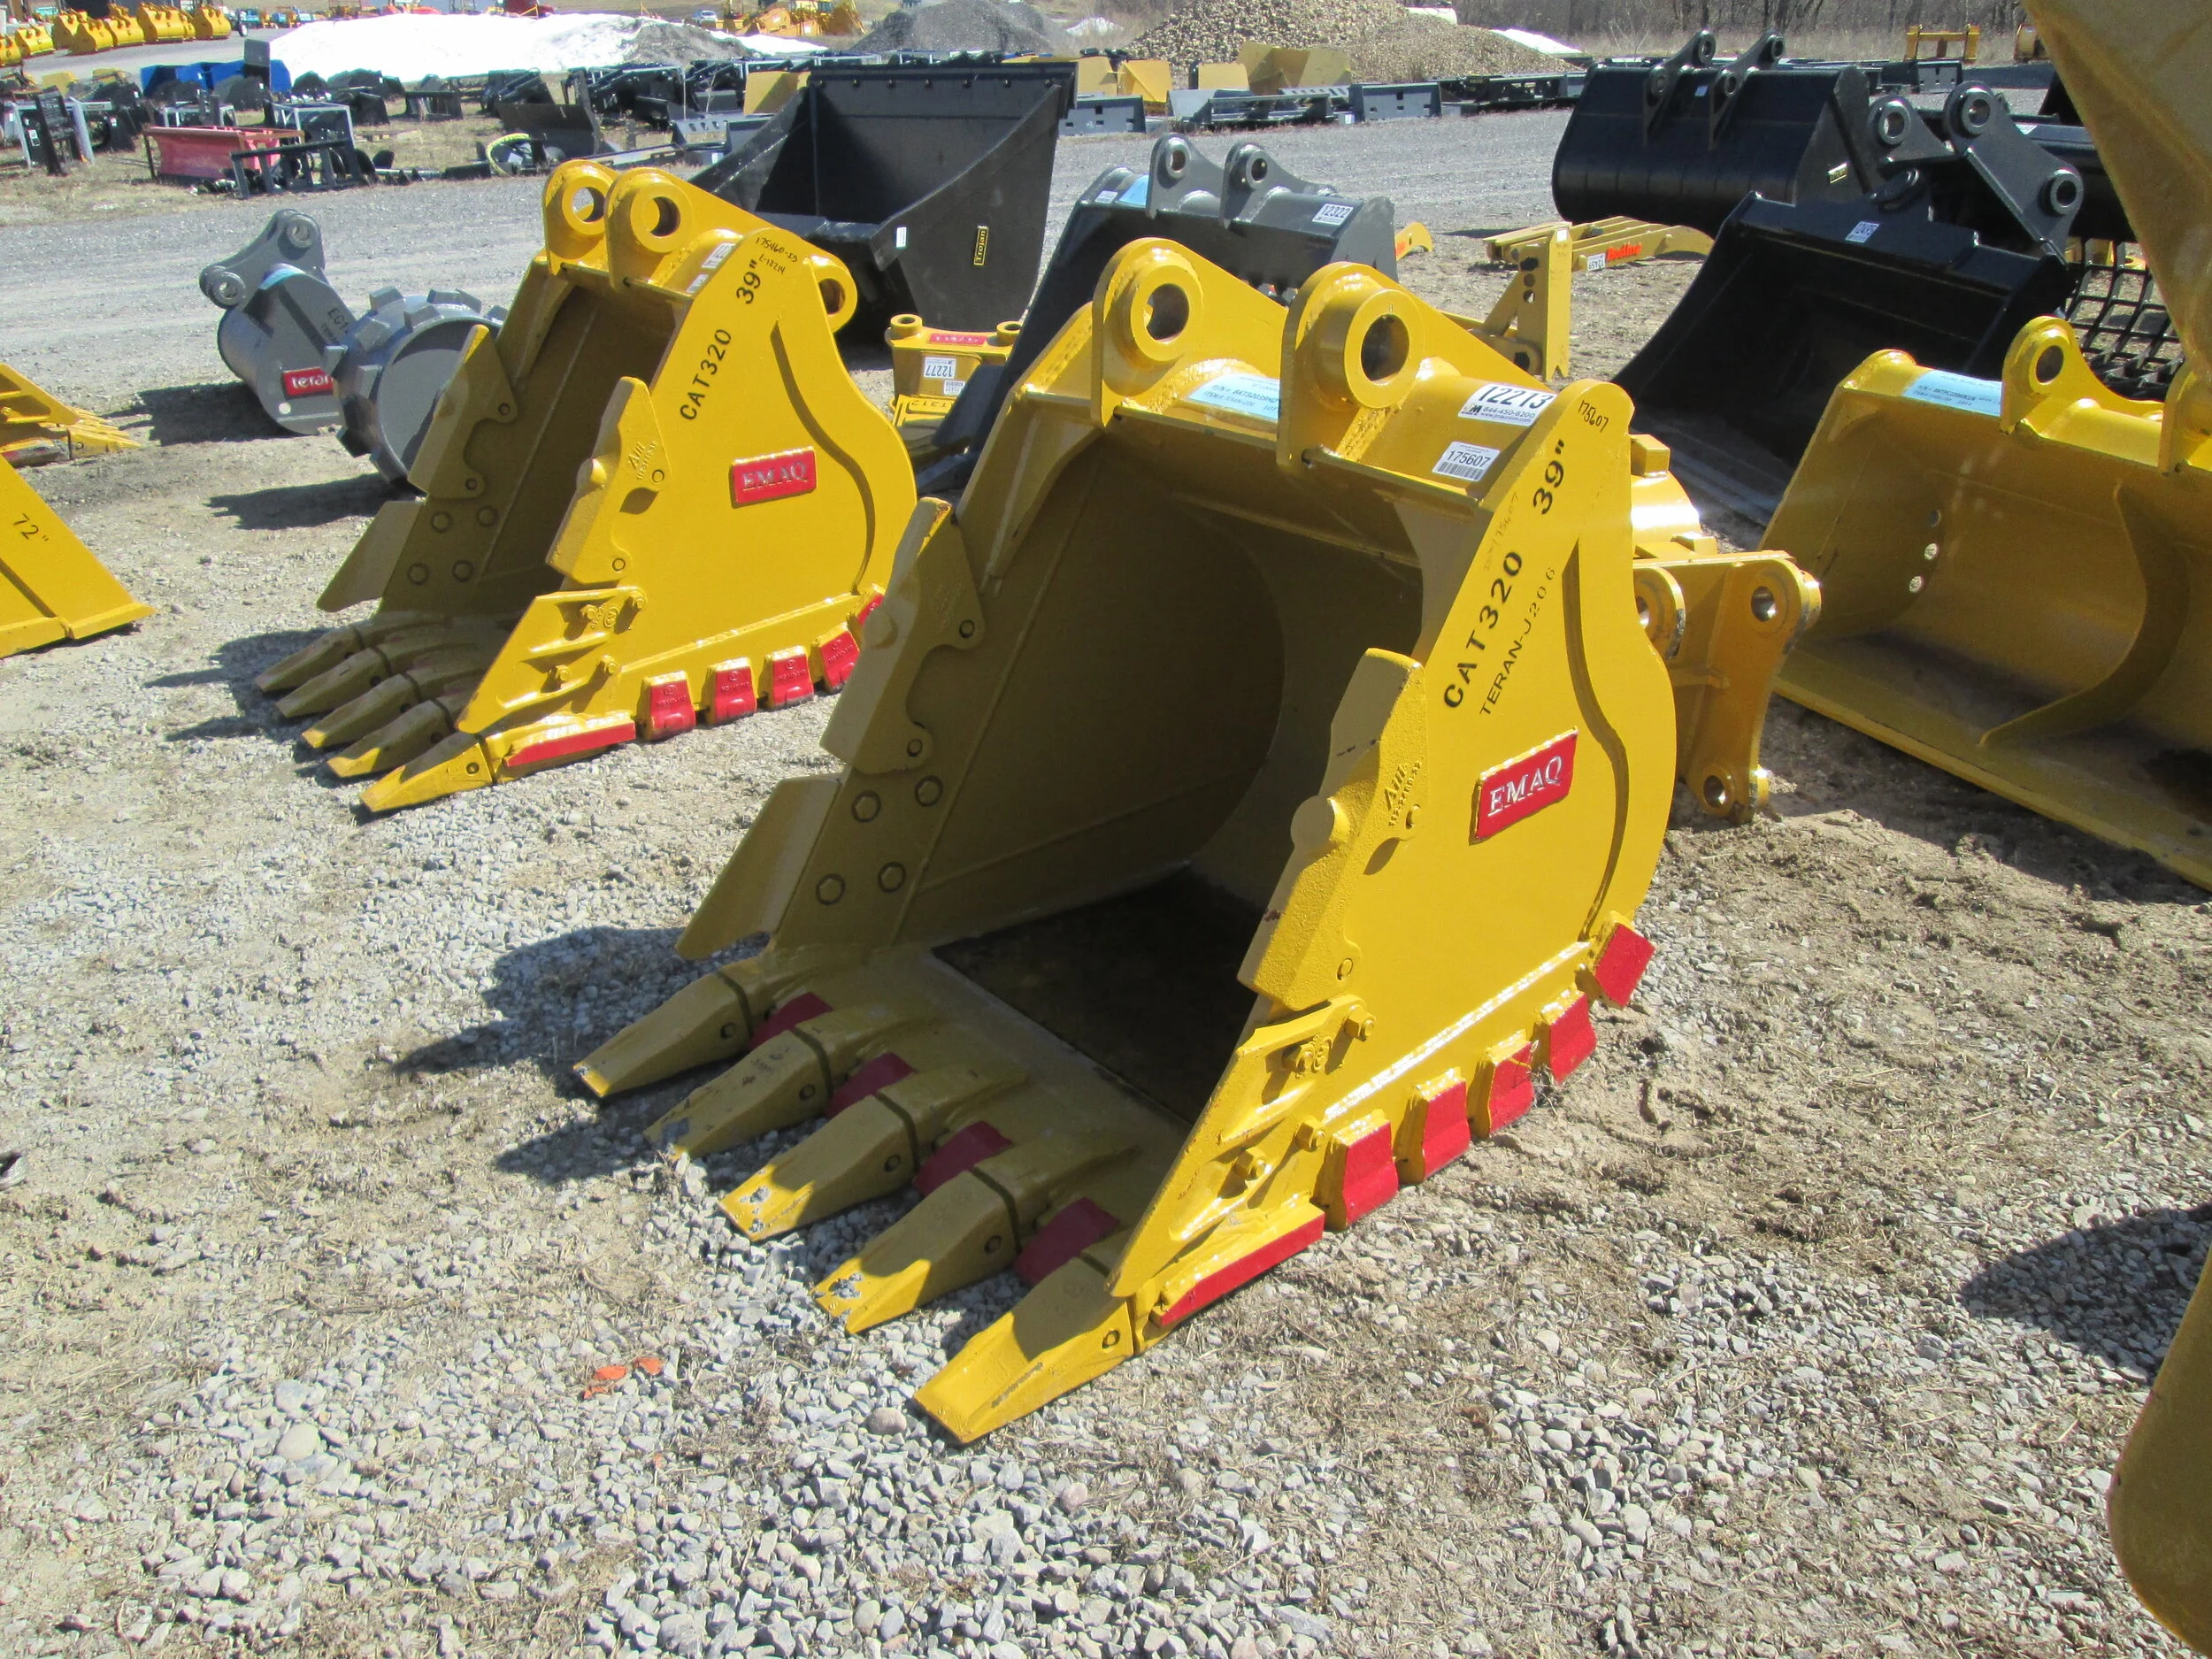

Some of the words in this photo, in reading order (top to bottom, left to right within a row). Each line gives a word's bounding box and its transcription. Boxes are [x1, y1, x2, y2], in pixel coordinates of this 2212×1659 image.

[1321, 204, 1350, 218] 12322
[976, 230, 986, 263] Trojan
[680, 328, 732, 421] CAT320
[925, 365, 953, 378] 12277
[1479, 385, 1555, 411] 12213
[1483, 406, 1535, 419] 844-450-6200
[1578, 399, 1609, 433] 175607
[1448, 449, 1492, 468] 175607
[743, 461, 809, 491] EMAQ
[12, 512, 50, 543] 72"
[1442, 550, 1524, 709] CAT320
[1532, 439, 1566, 515] 39"
[1479, 566, 1555, 716] TERAN-J206
[1487, 755, 1563, 817] EMAQ
